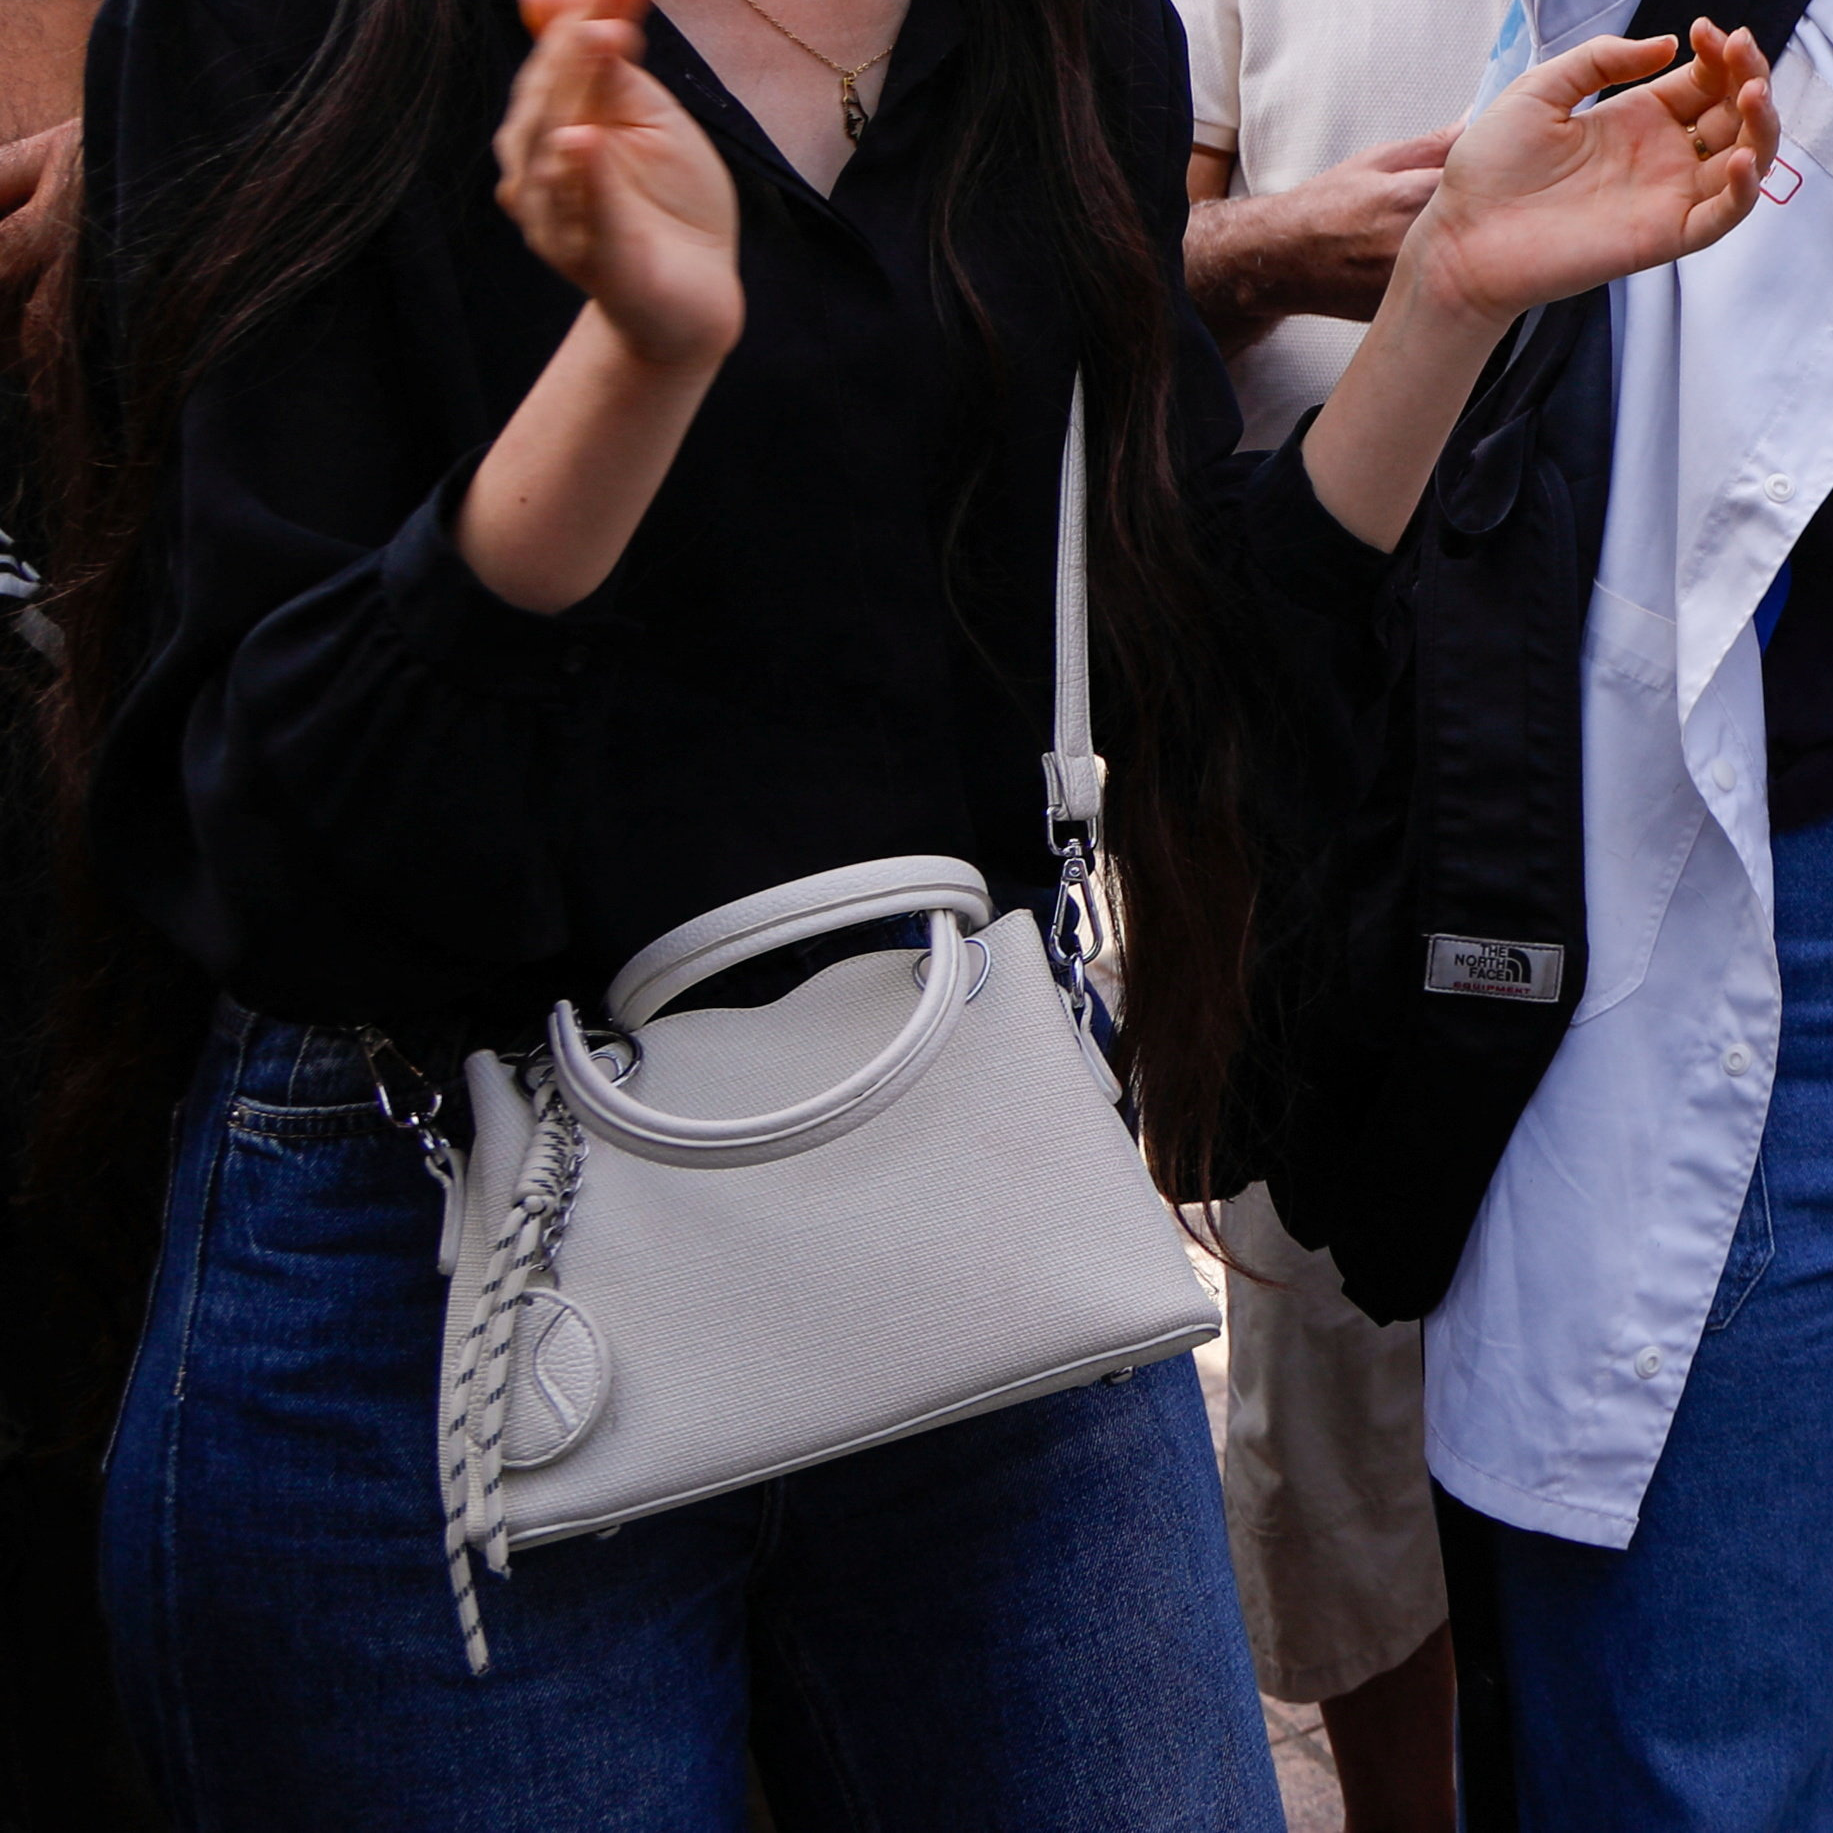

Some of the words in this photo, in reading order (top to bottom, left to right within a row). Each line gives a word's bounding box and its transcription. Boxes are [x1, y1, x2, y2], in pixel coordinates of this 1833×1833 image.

[1479, 943, 1508, 958] THE
[1453, 953, 1509, 971] NORTH
[1468, 967, 1508, 983] FACE
